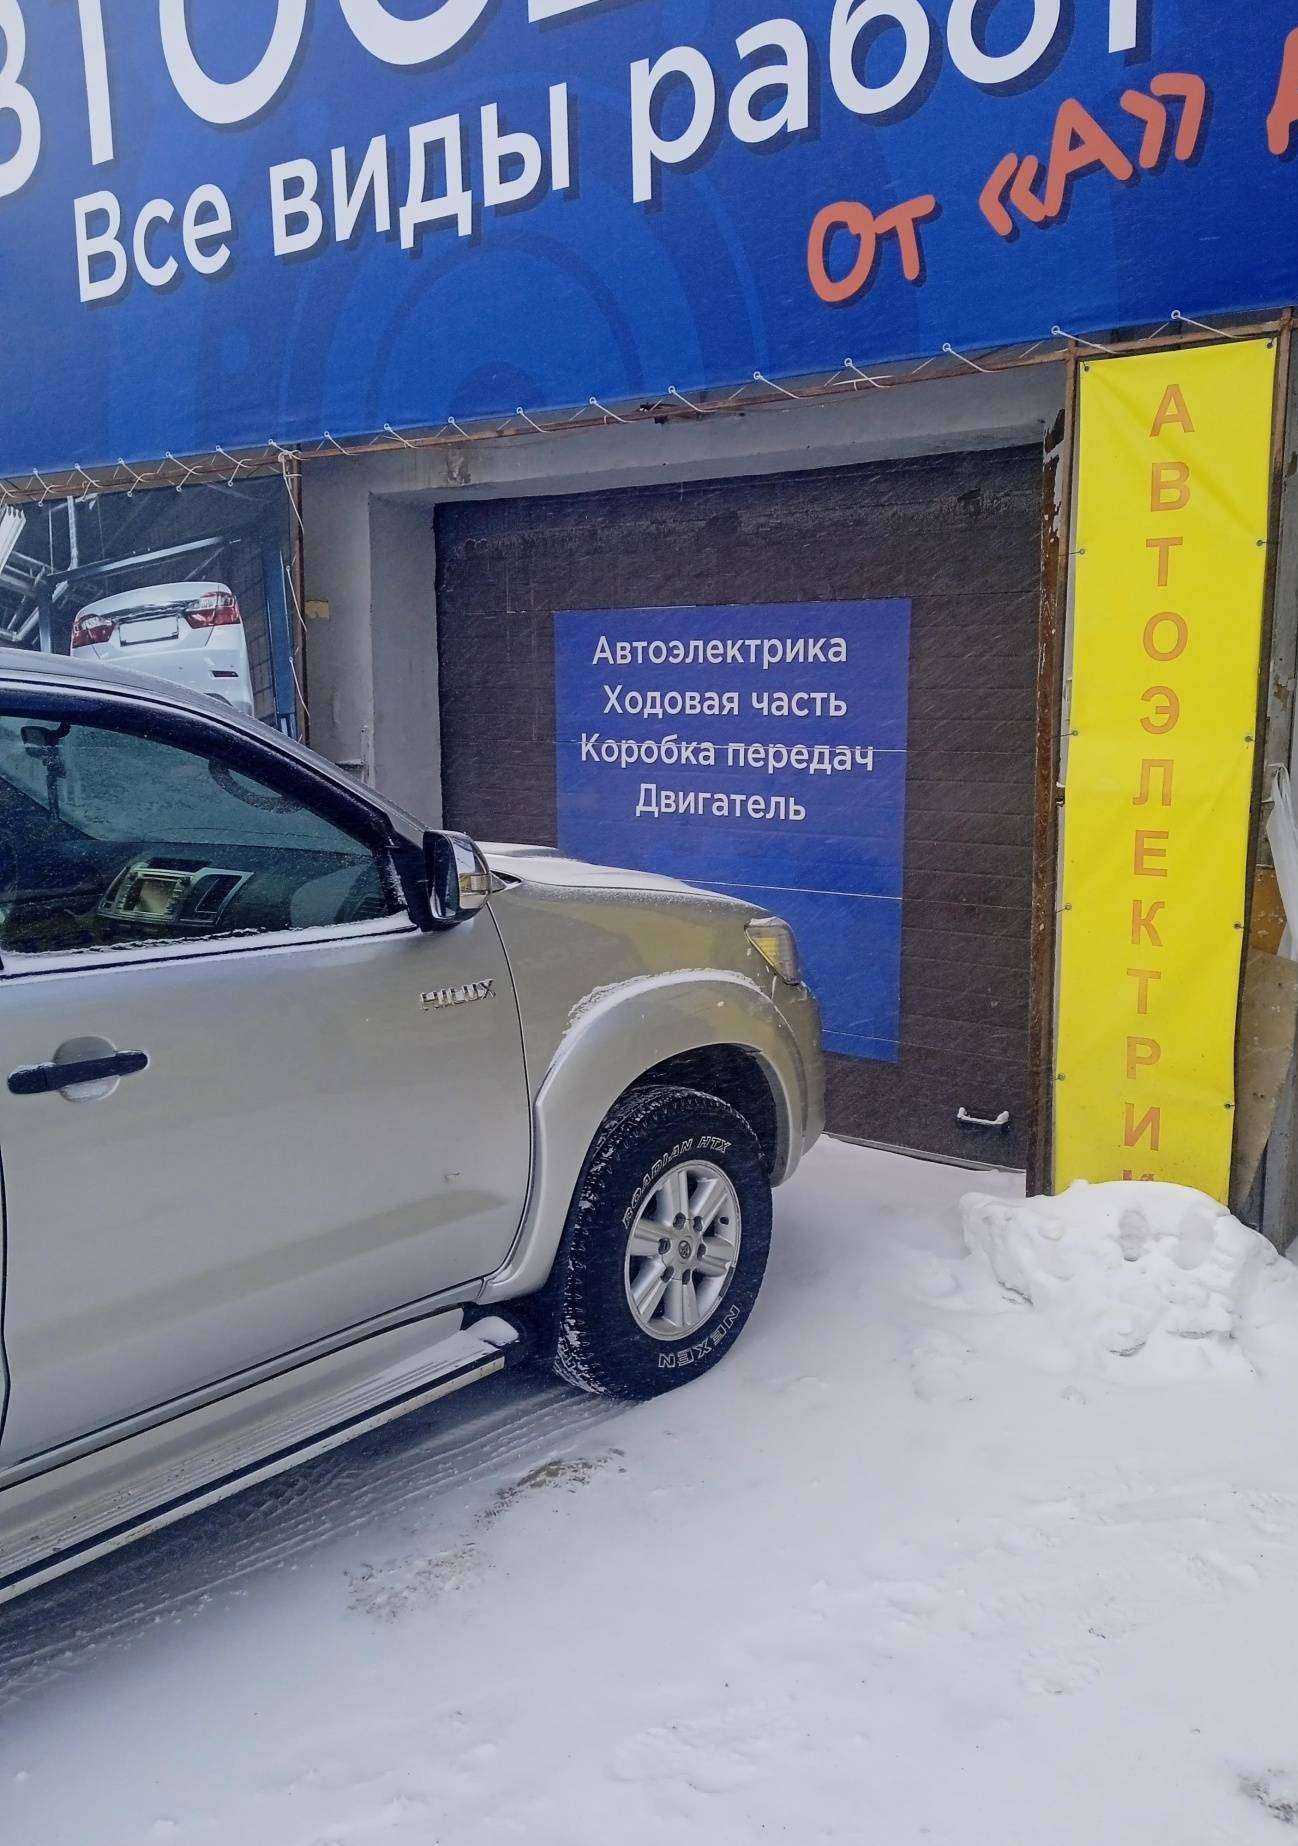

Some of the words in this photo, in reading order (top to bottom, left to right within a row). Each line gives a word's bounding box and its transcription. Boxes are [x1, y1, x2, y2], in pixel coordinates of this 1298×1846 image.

[74, 183, 232, 302] Все
[269, 82, 570, 250] виды
[592, 635, 848, 669] Автоэлектрика
[603, 685, 739, 719] Ходовая
[751, 691, 847, 717] часть
[580, 733, 715, 768] Коробка
[727, 742, 874, 774] передач
[1120, 383, 1195, 1181] АВТОЭЛЕКТРИ
[635, 783, 806, 821] Двигатель
[420, 979, 497, 1011] HILUX
[658, 1304, 741, 1369] NEXEN
